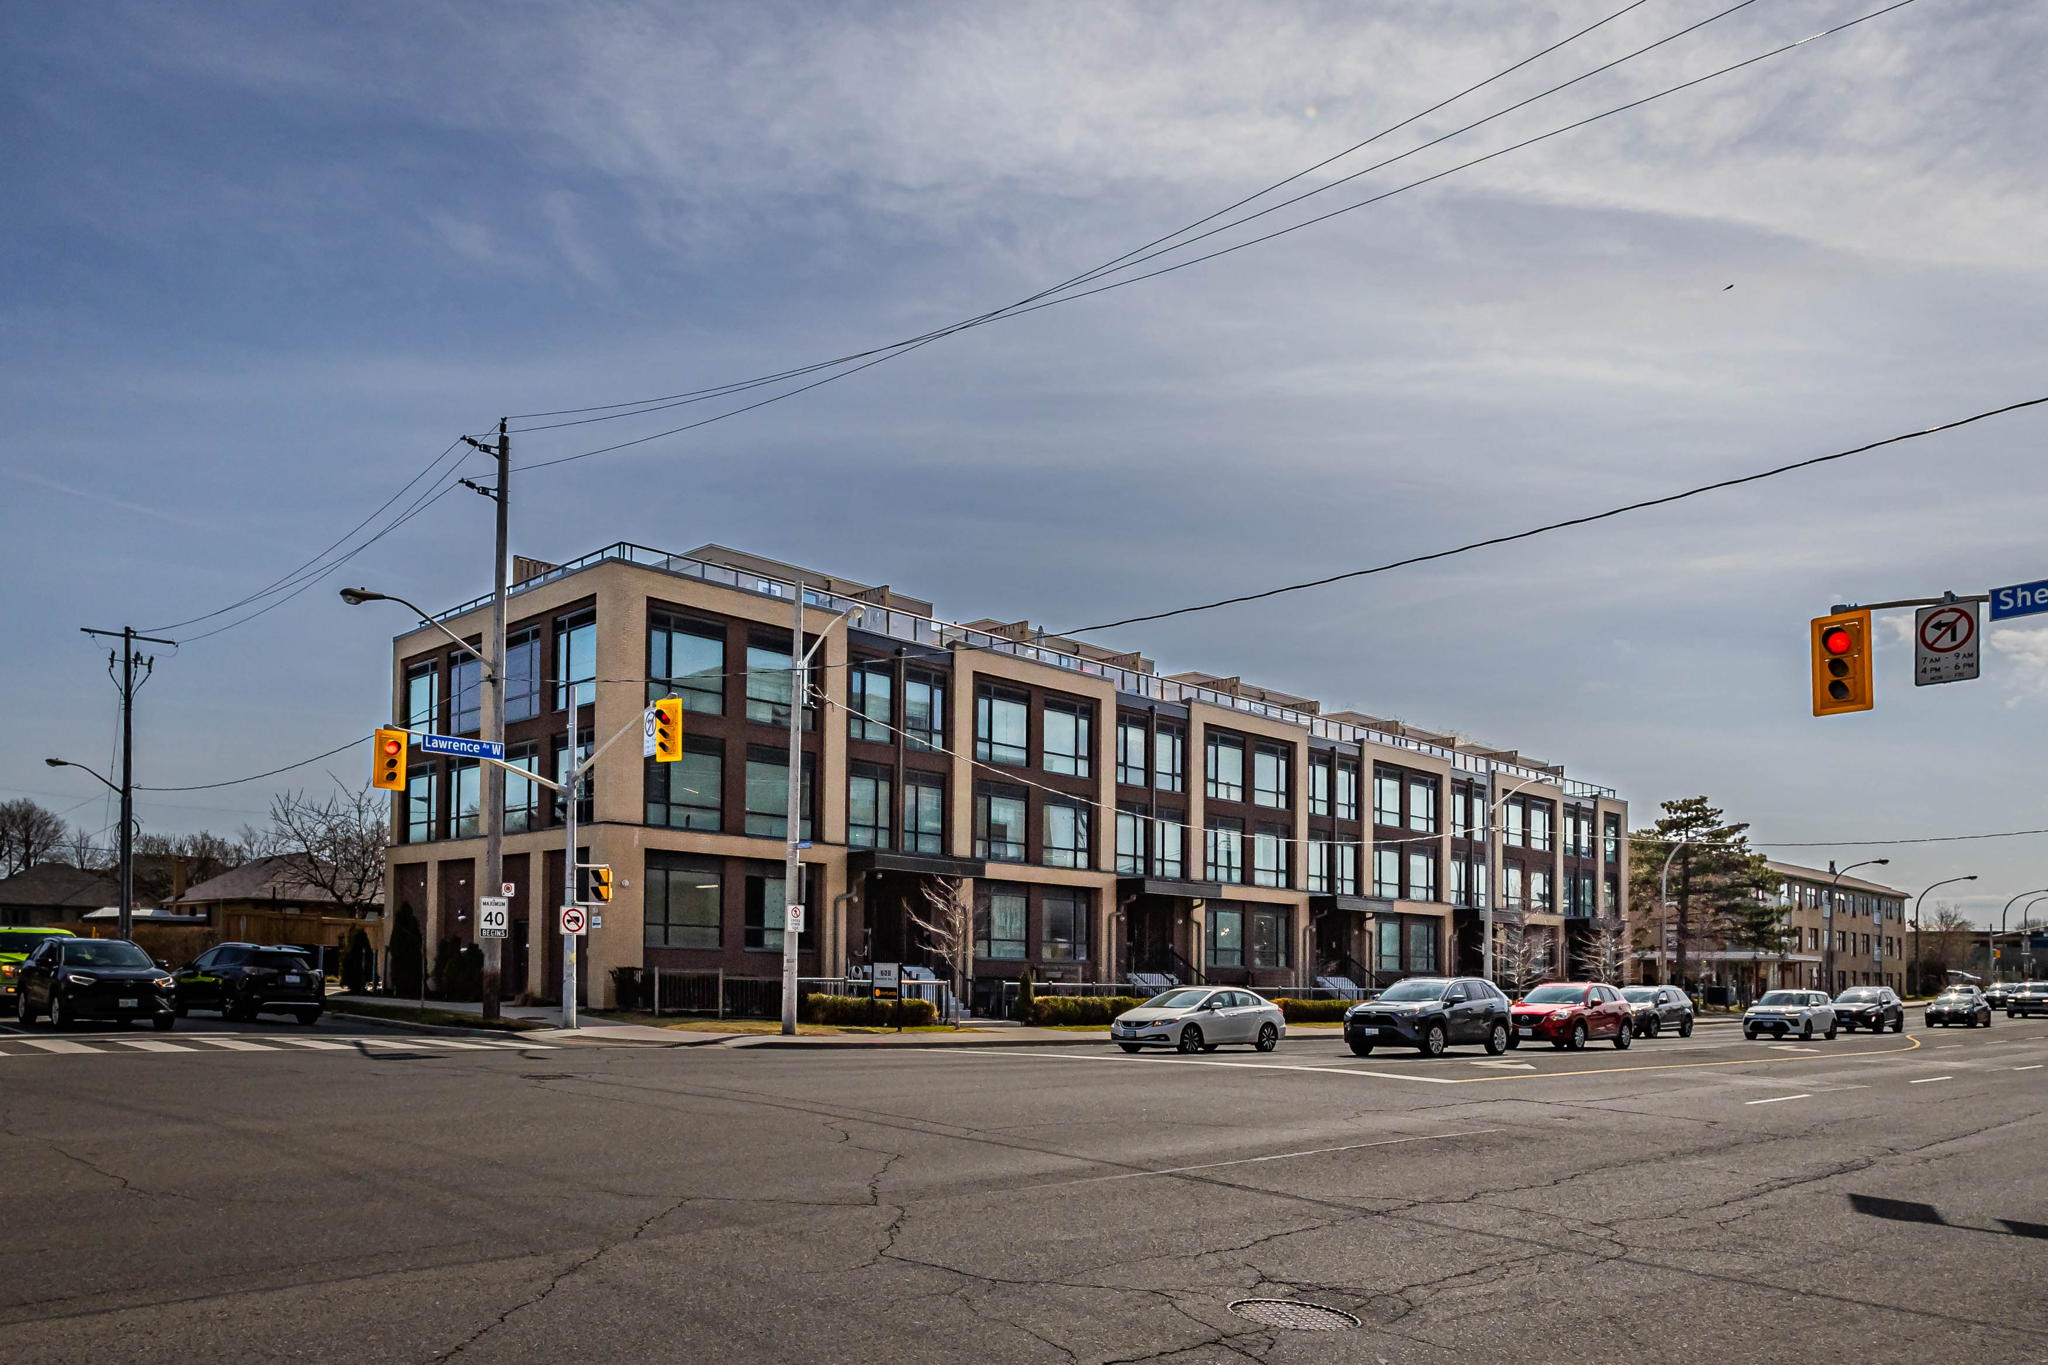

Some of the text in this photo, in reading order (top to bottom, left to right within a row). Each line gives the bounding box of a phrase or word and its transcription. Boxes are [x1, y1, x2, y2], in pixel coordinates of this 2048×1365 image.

[1999, 588, 2048, 609] She
[1921, 657, 1927, 665] 7
[1929, 656, 1940, 664] AM
[1954, 652, 1960, 660] 9
[1954, 662, 1960, 670] 6
[425, 736, 480, 753] Lawrence
[492, 744, 501, 755] W
[483, 911, 505, 926] 40
